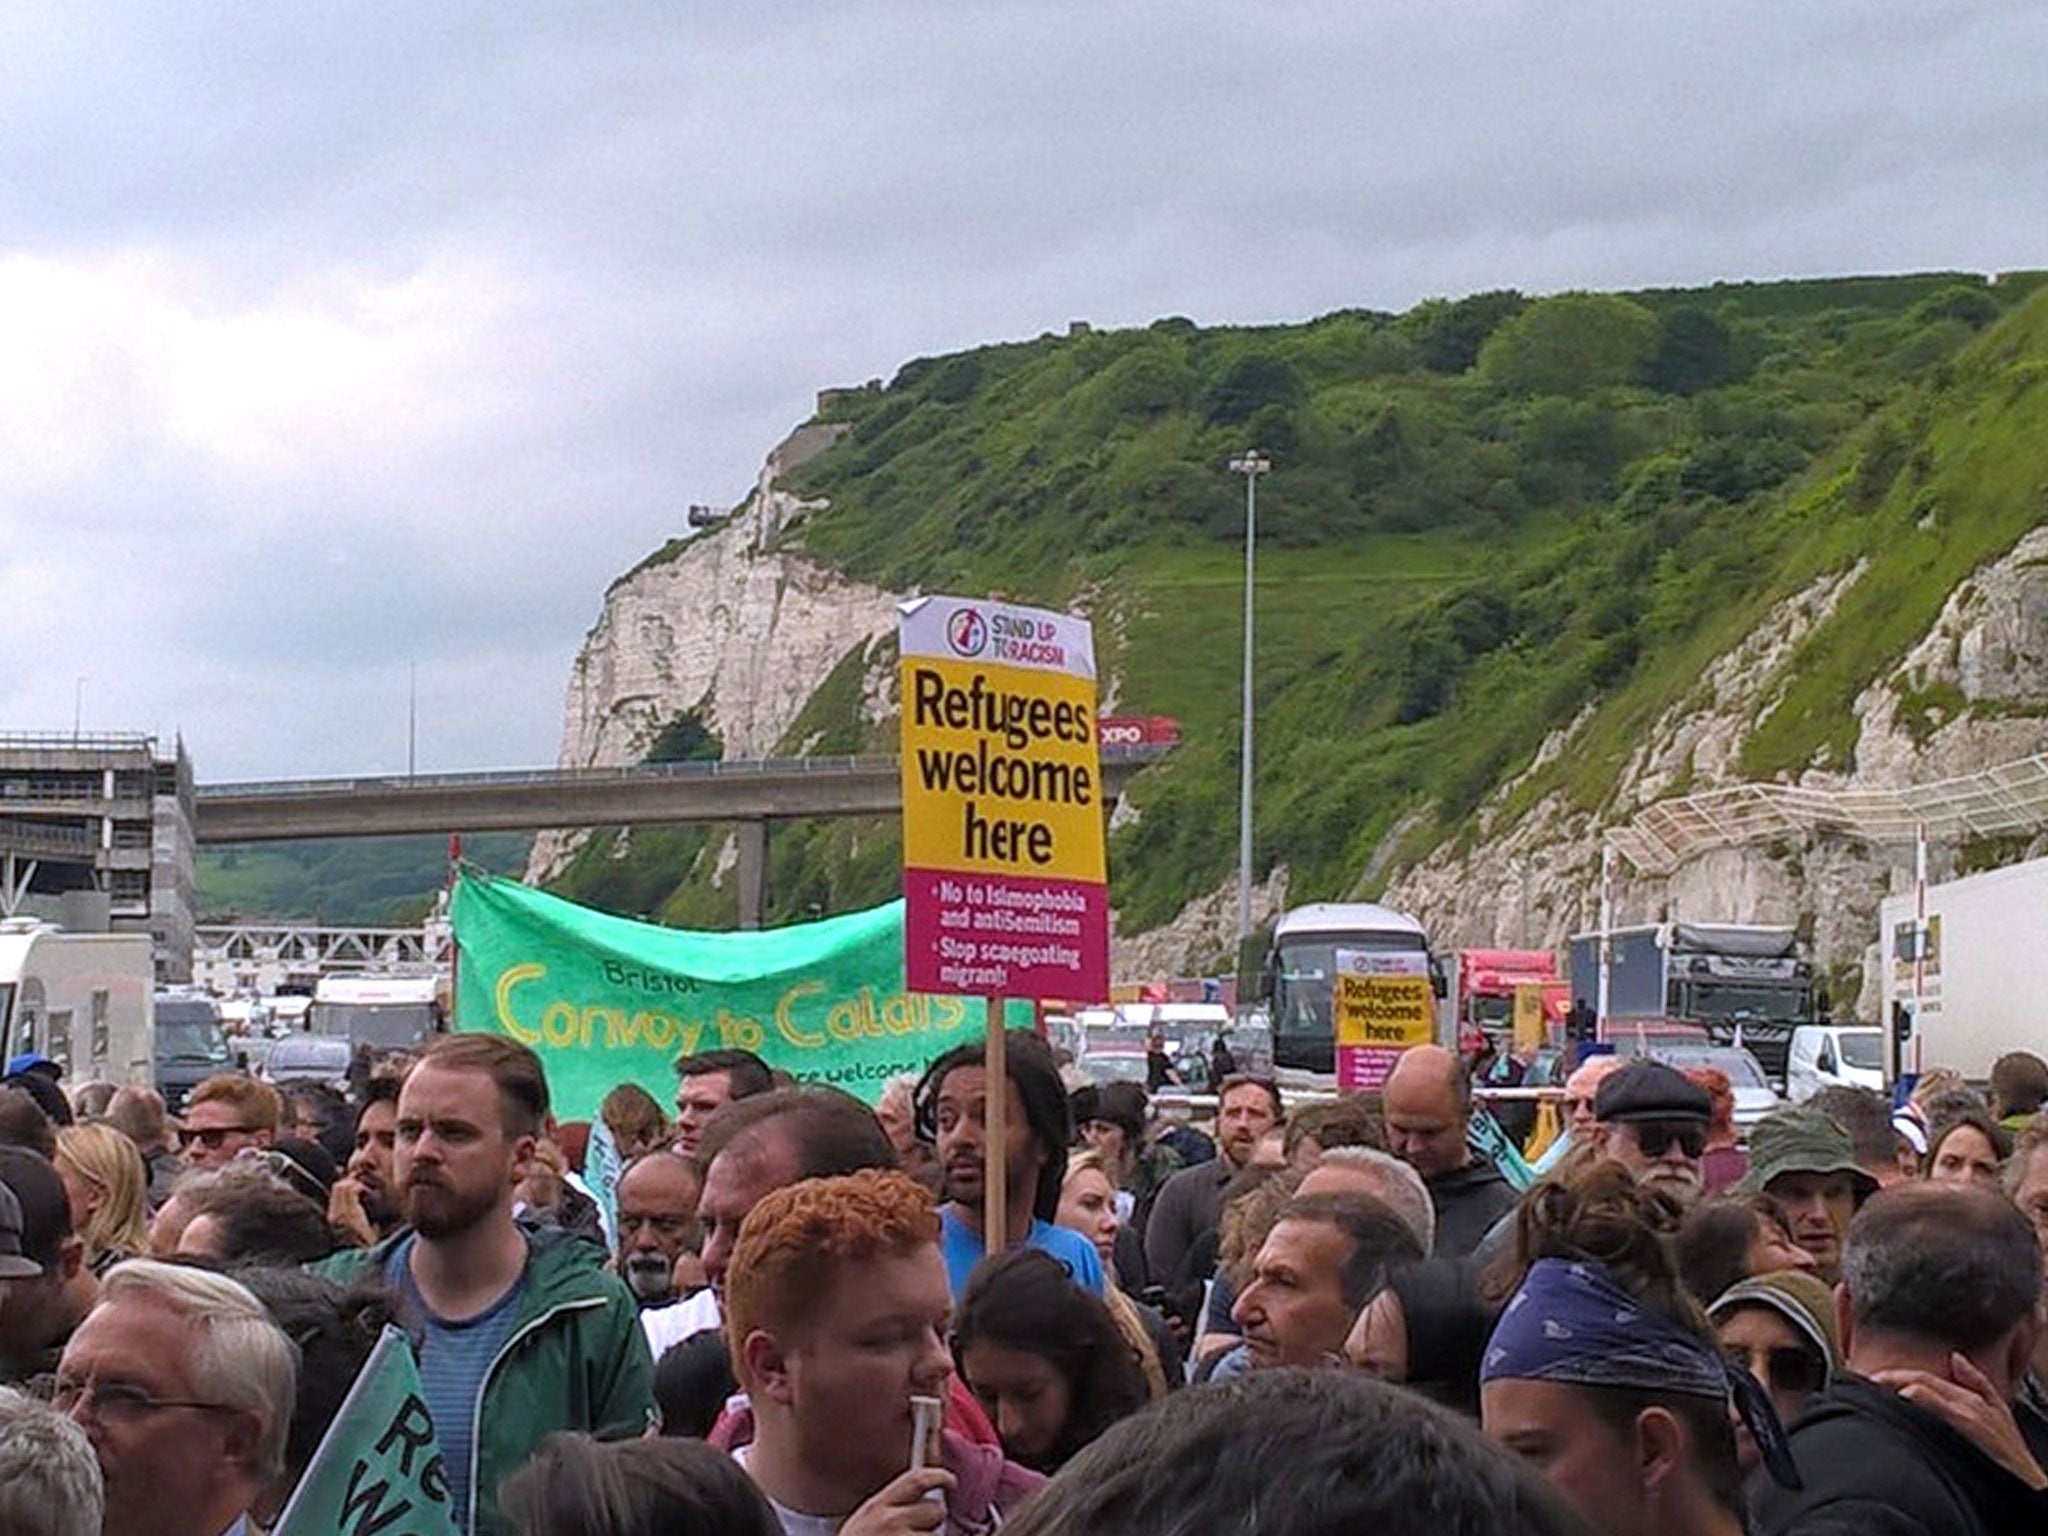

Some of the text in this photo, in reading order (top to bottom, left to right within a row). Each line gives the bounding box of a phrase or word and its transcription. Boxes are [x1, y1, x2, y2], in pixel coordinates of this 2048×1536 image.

[915, 669, 1090, 750] Refugees
[917, 739, 1092, 805] welcome
[964, 801, 1053, 864] here
[940, 881, 963, 903] No
[966, 884, 984, 904] to
[940, 908, 970, 929] and
[940, 937, 978, 965] Stop
[604, 960, 701, 994] Bristol
[1344, 979, 1423, 1005] Refugees
[496, 963, 966, 1066] Convoy to Calais
[1345, 1001, 1422, 1021] welcome
[1365, 1021, 1405, 1042] here
